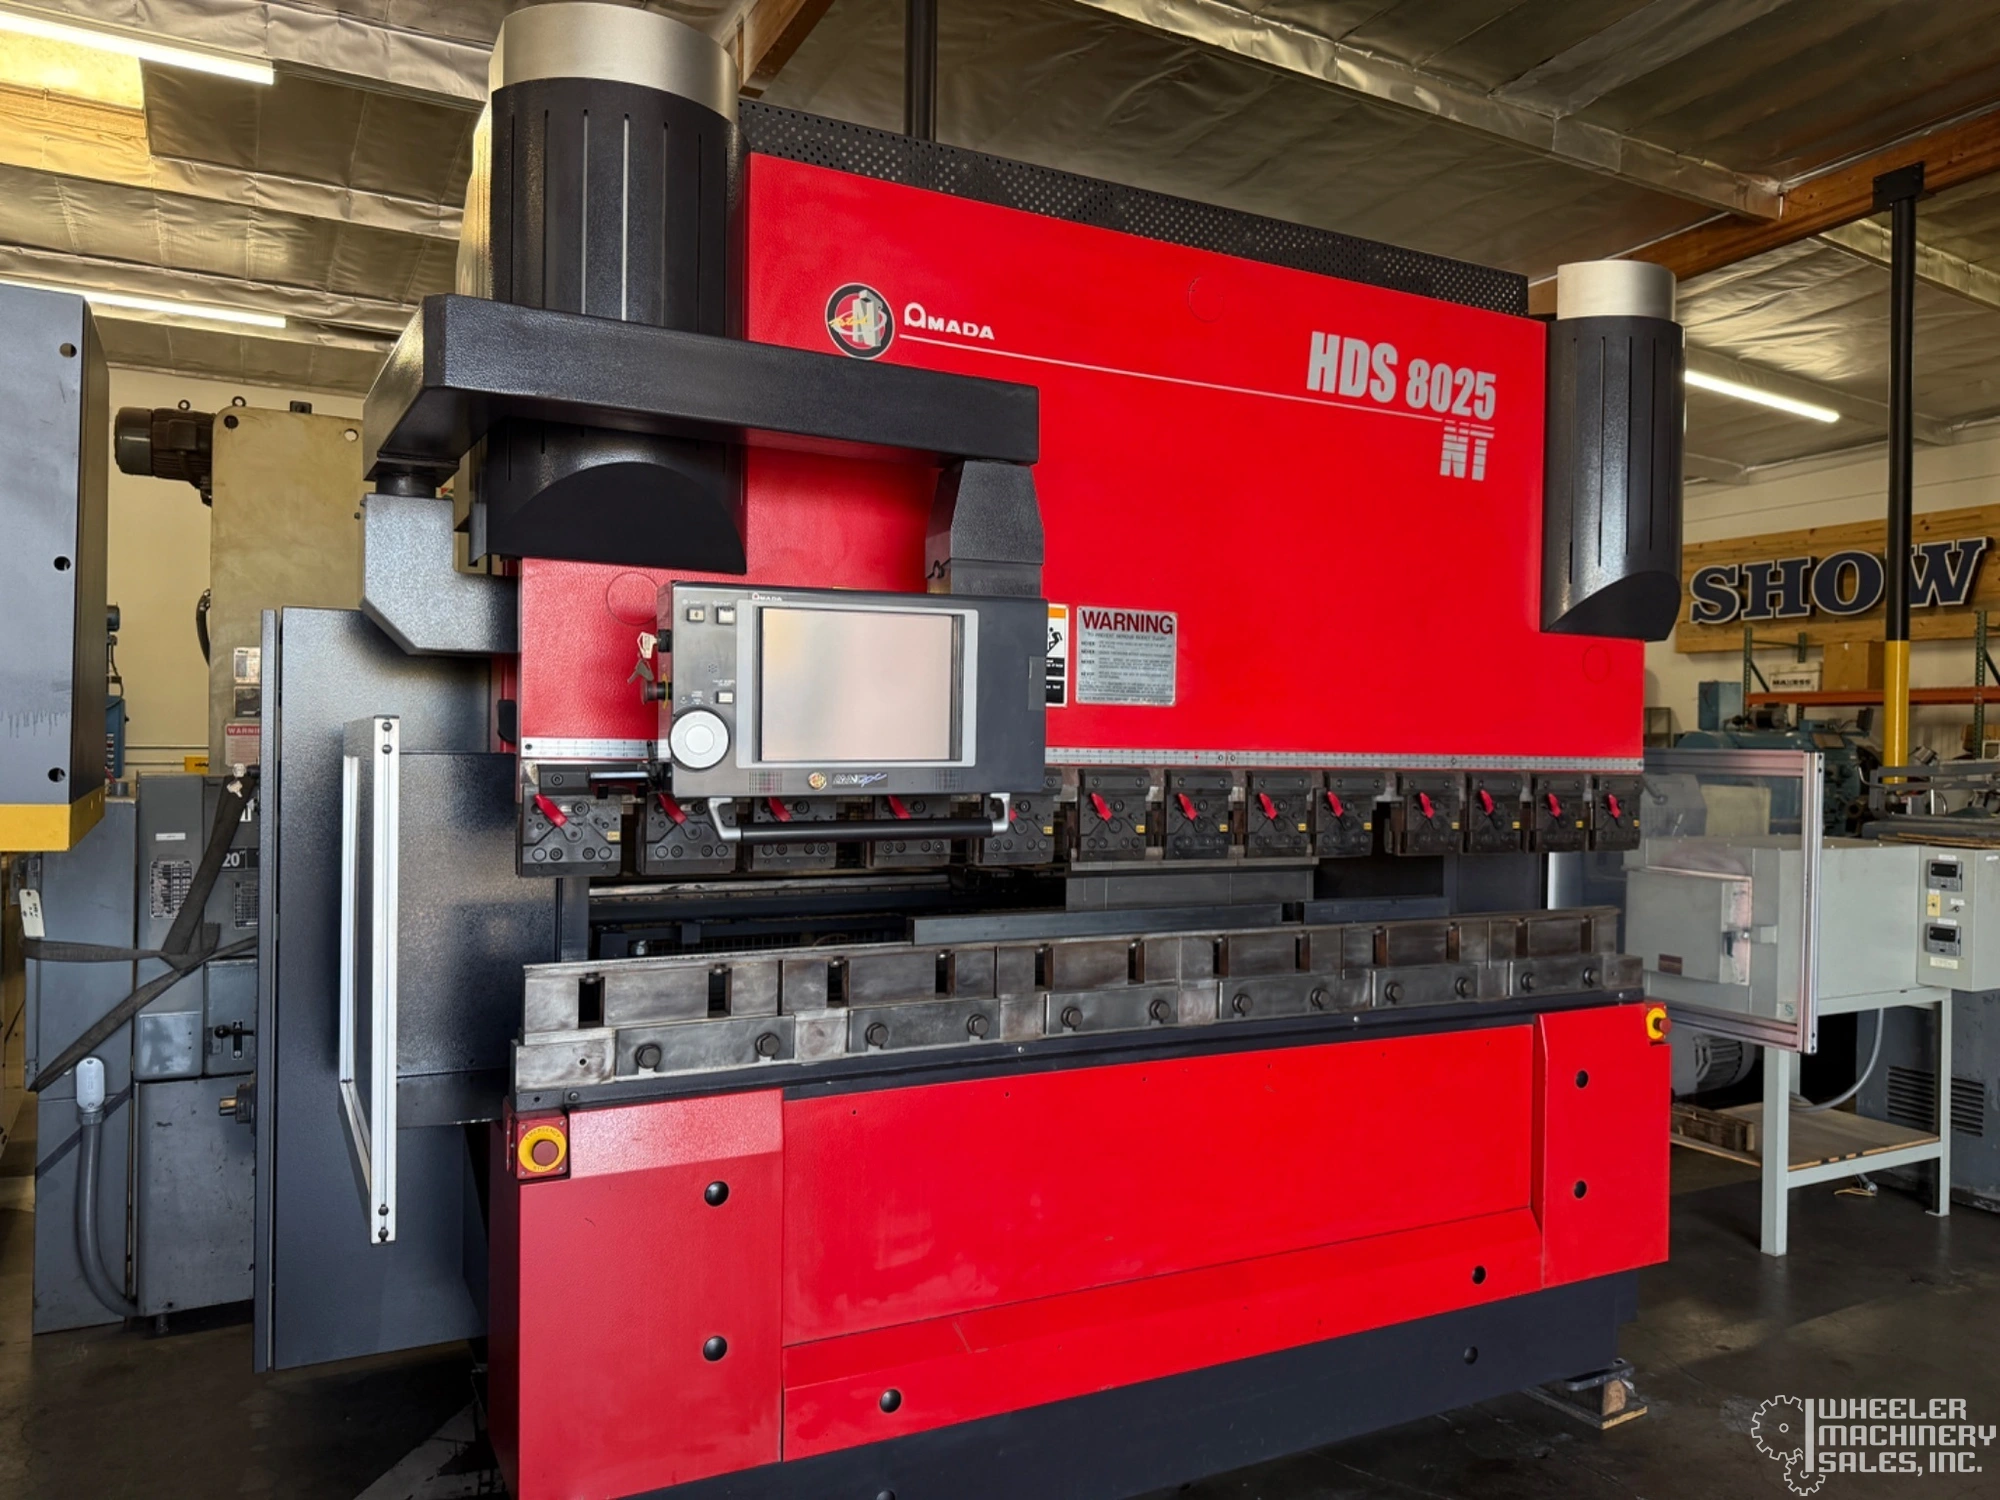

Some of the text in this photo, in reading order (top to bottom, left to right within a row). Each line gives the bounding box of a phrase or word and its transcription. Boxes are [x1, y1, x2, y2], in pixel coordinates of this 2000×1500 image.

[1306, 331, 1497, 421] HDS 8025
[1082, 610, 1174, 635] WARNING
[1689, 537, 1987, 625] SHOW
